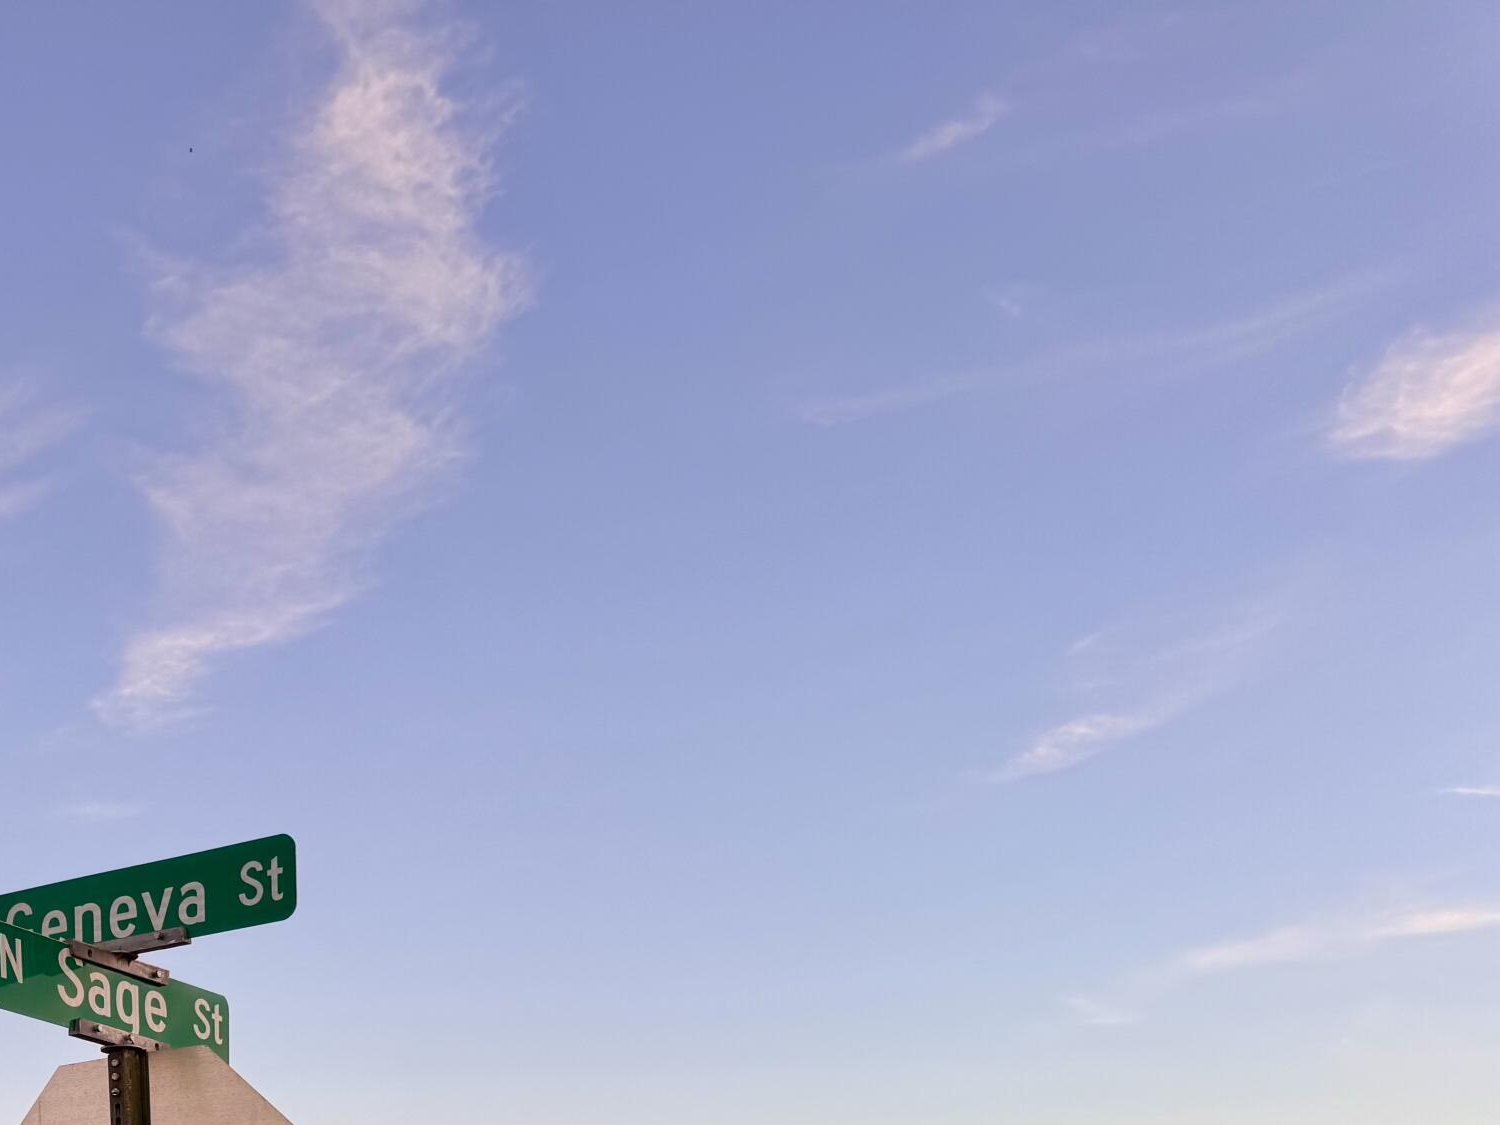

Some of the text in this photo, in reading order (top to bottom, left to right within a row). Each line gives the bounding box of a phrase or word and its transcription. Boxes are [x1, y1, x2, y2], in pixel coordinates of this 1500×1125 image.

[238, 855, 284, 906] St
[0, 933, 223, 1045] N Sage St
